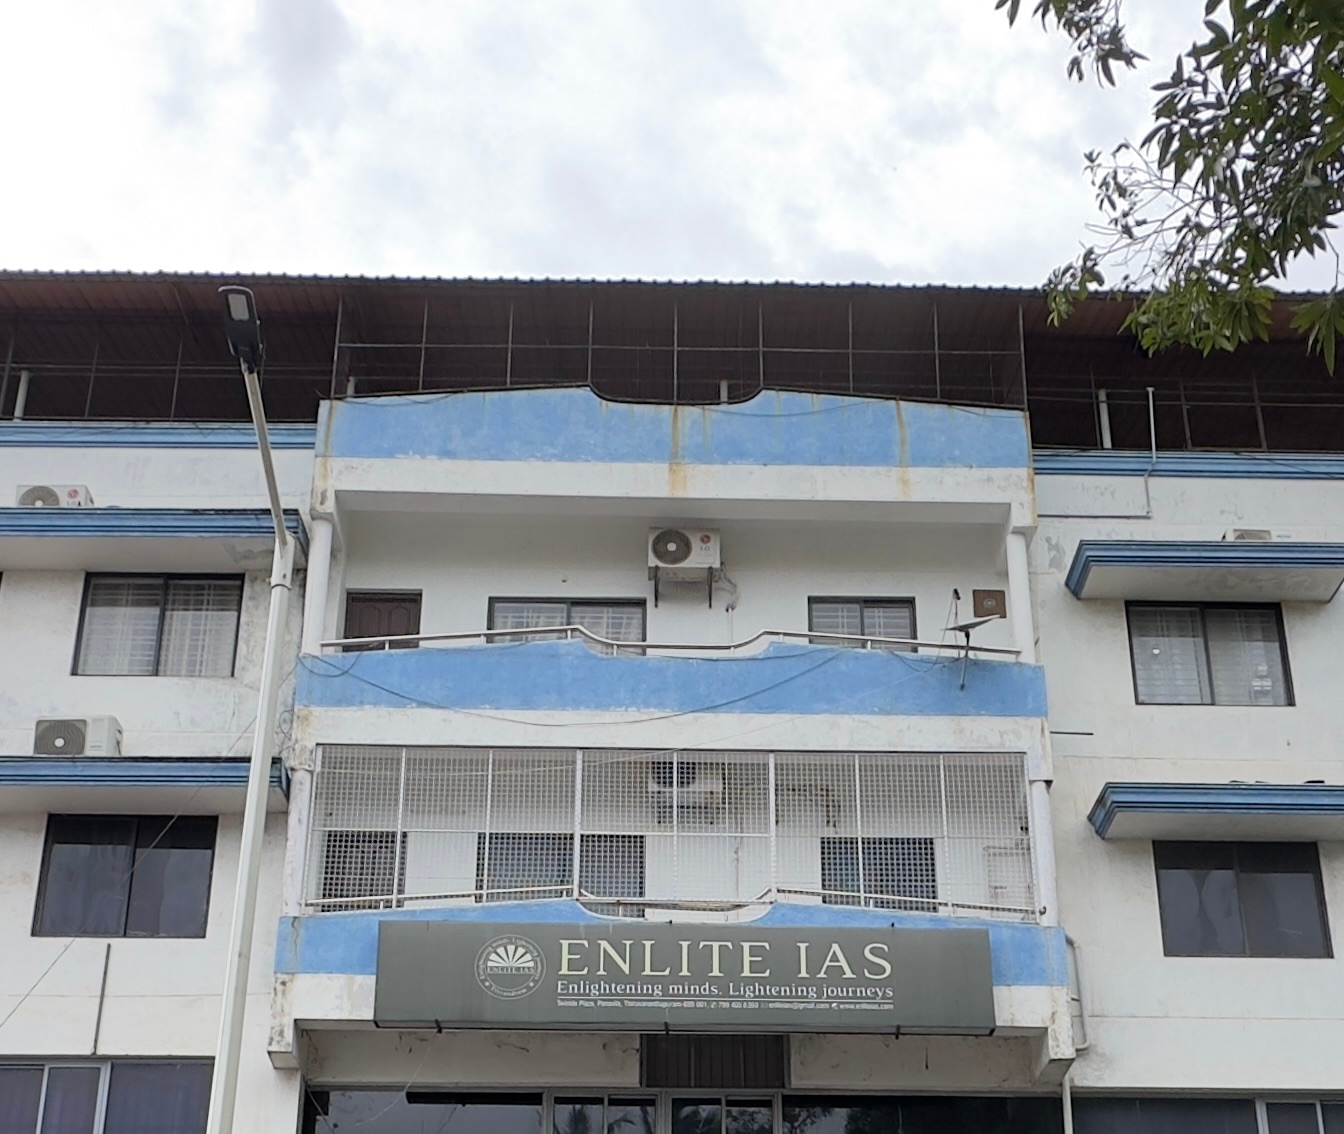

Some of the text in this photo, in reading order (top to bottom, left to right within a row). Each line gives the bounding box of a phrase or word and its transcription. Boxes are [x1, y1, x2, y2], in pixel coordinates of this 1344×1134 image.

[558, 939, 770, 977] ENLITE
[796, 942, 892, 980] IAS
[557, 980, 894, 999] Enlightening minds. Lightening journeys
